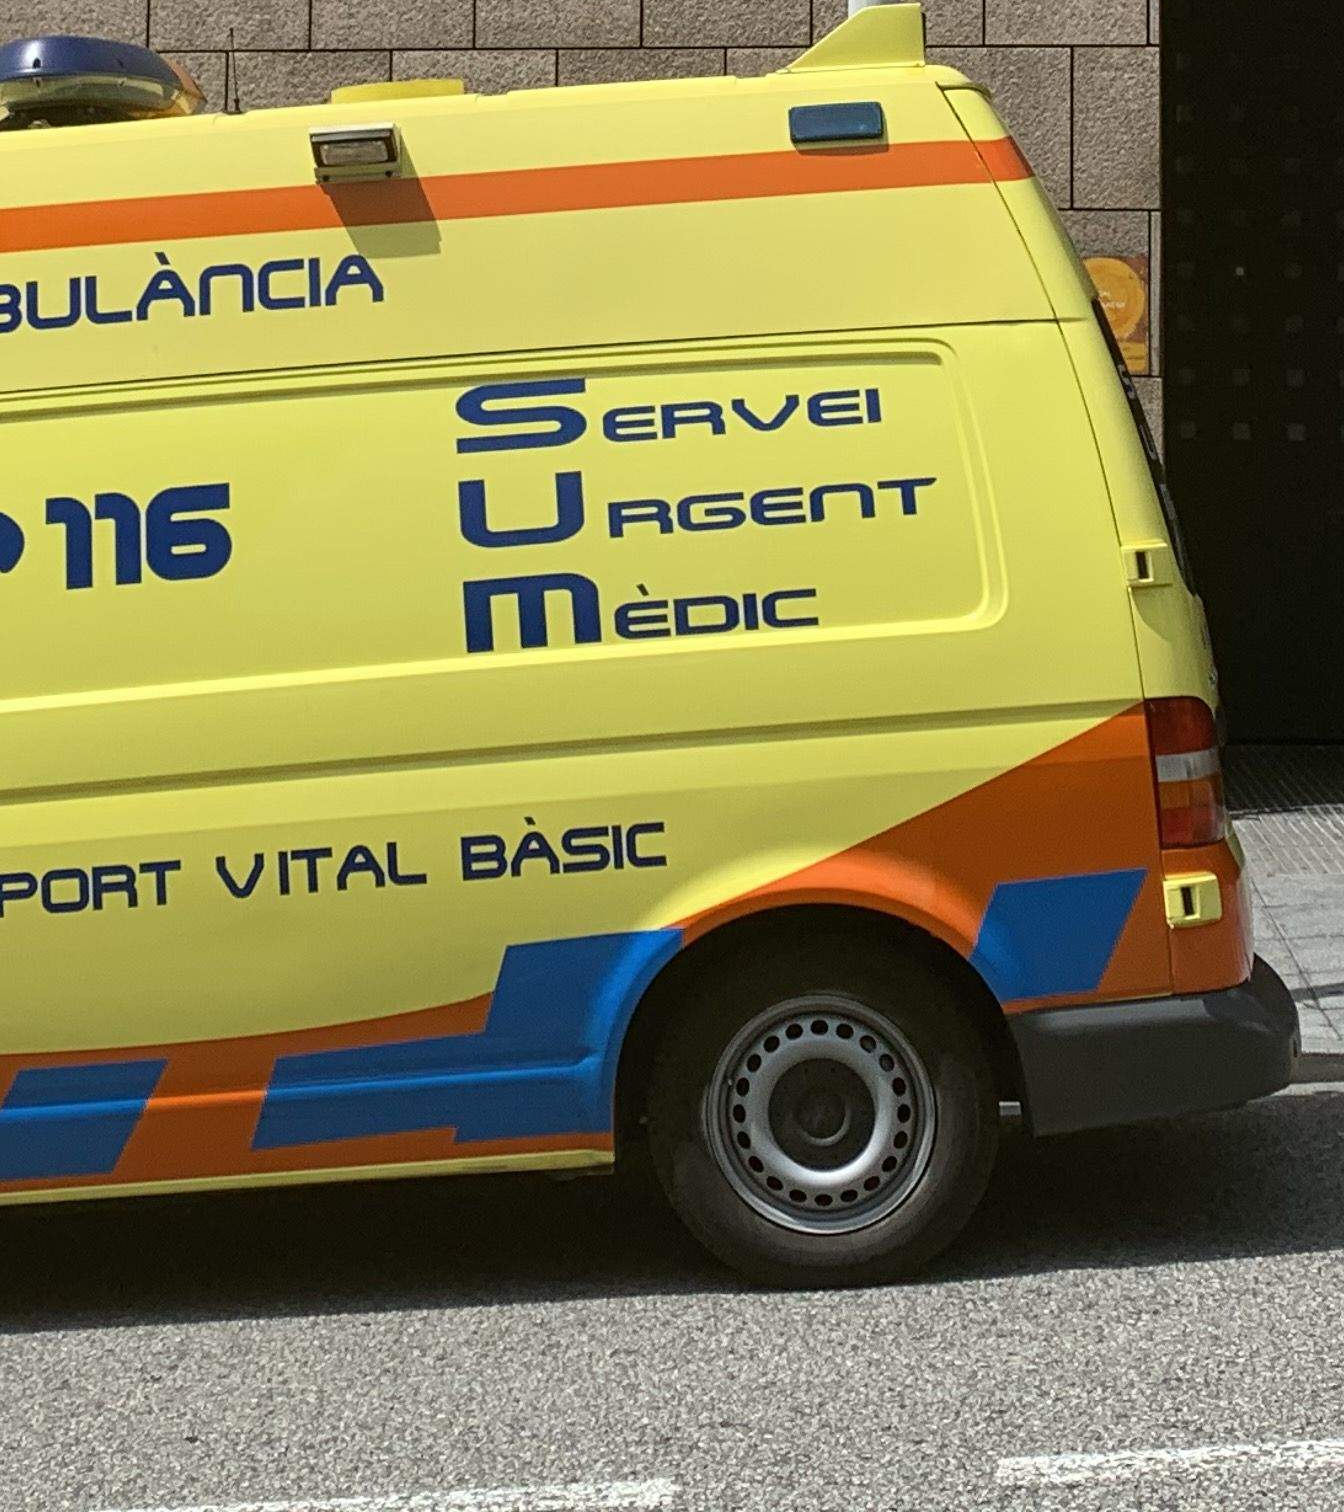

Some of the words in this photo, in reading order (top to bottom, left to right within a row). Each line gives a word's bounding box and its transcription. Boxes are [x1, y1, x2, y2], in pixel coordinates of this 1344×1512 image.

[455, 377, 882, 454] SERVEI
[45, 482, 233, 590] 116
[458, 470, 937, 549] URGENT
[215, 841, 428, 899] VITAL
[460, 816, 668, 882] BÀSIC
